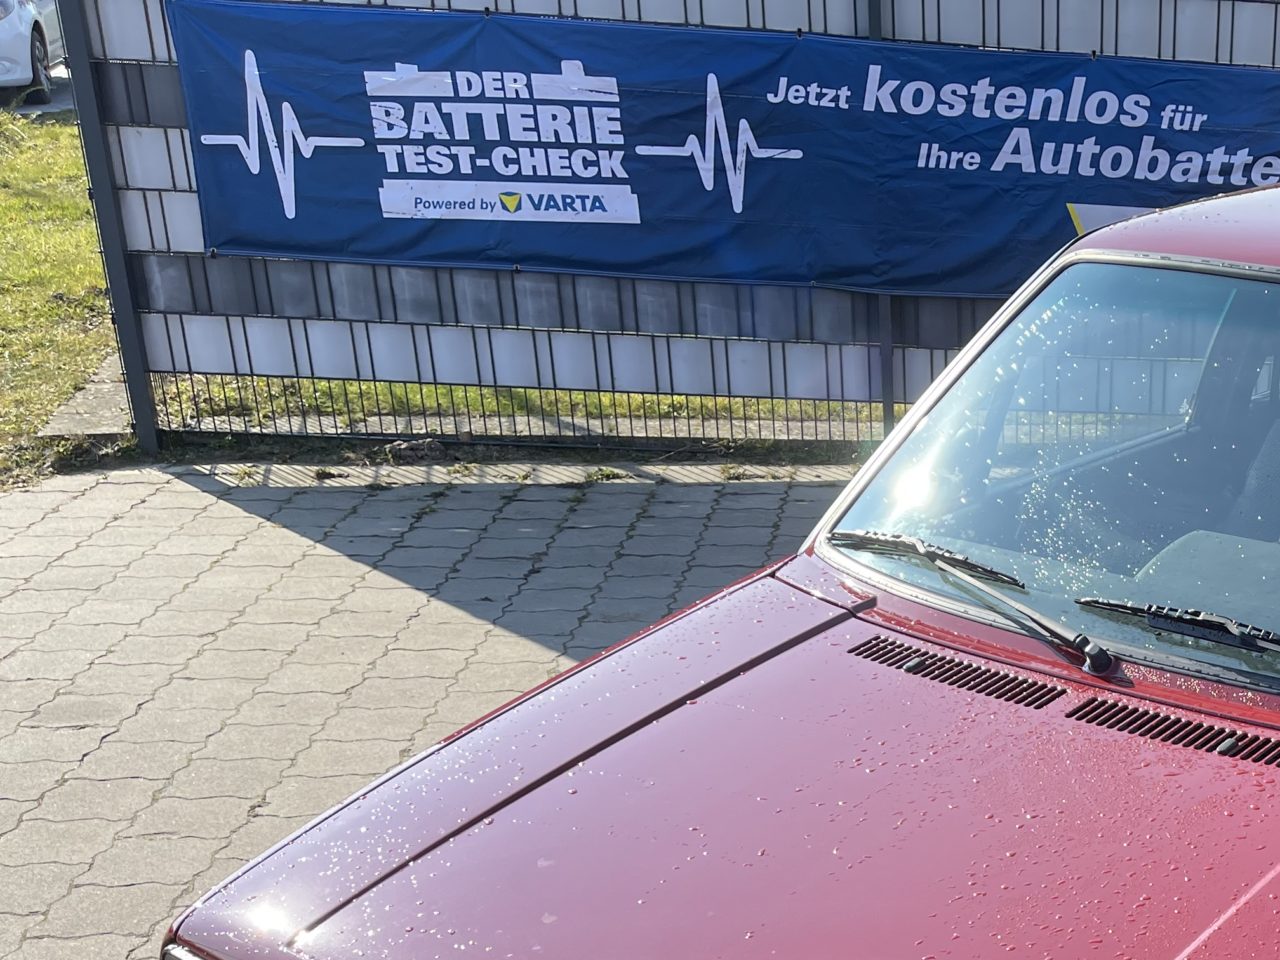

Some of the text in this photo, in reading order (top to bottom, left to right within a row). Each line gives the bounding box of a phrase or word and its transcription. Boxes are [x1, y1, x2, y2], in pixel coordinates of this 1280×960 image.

[456, 71, 530, 98] DER
[767, 64, 1208, 132] Jetzt kostenlos für
[369, 101, 625, 145] BATTERIE
[377, 145, 629, 179] TEST-CHECK
[917, 143, 981, 171] Ihre
[414, 193, 608, 213] Powered by VARTA
